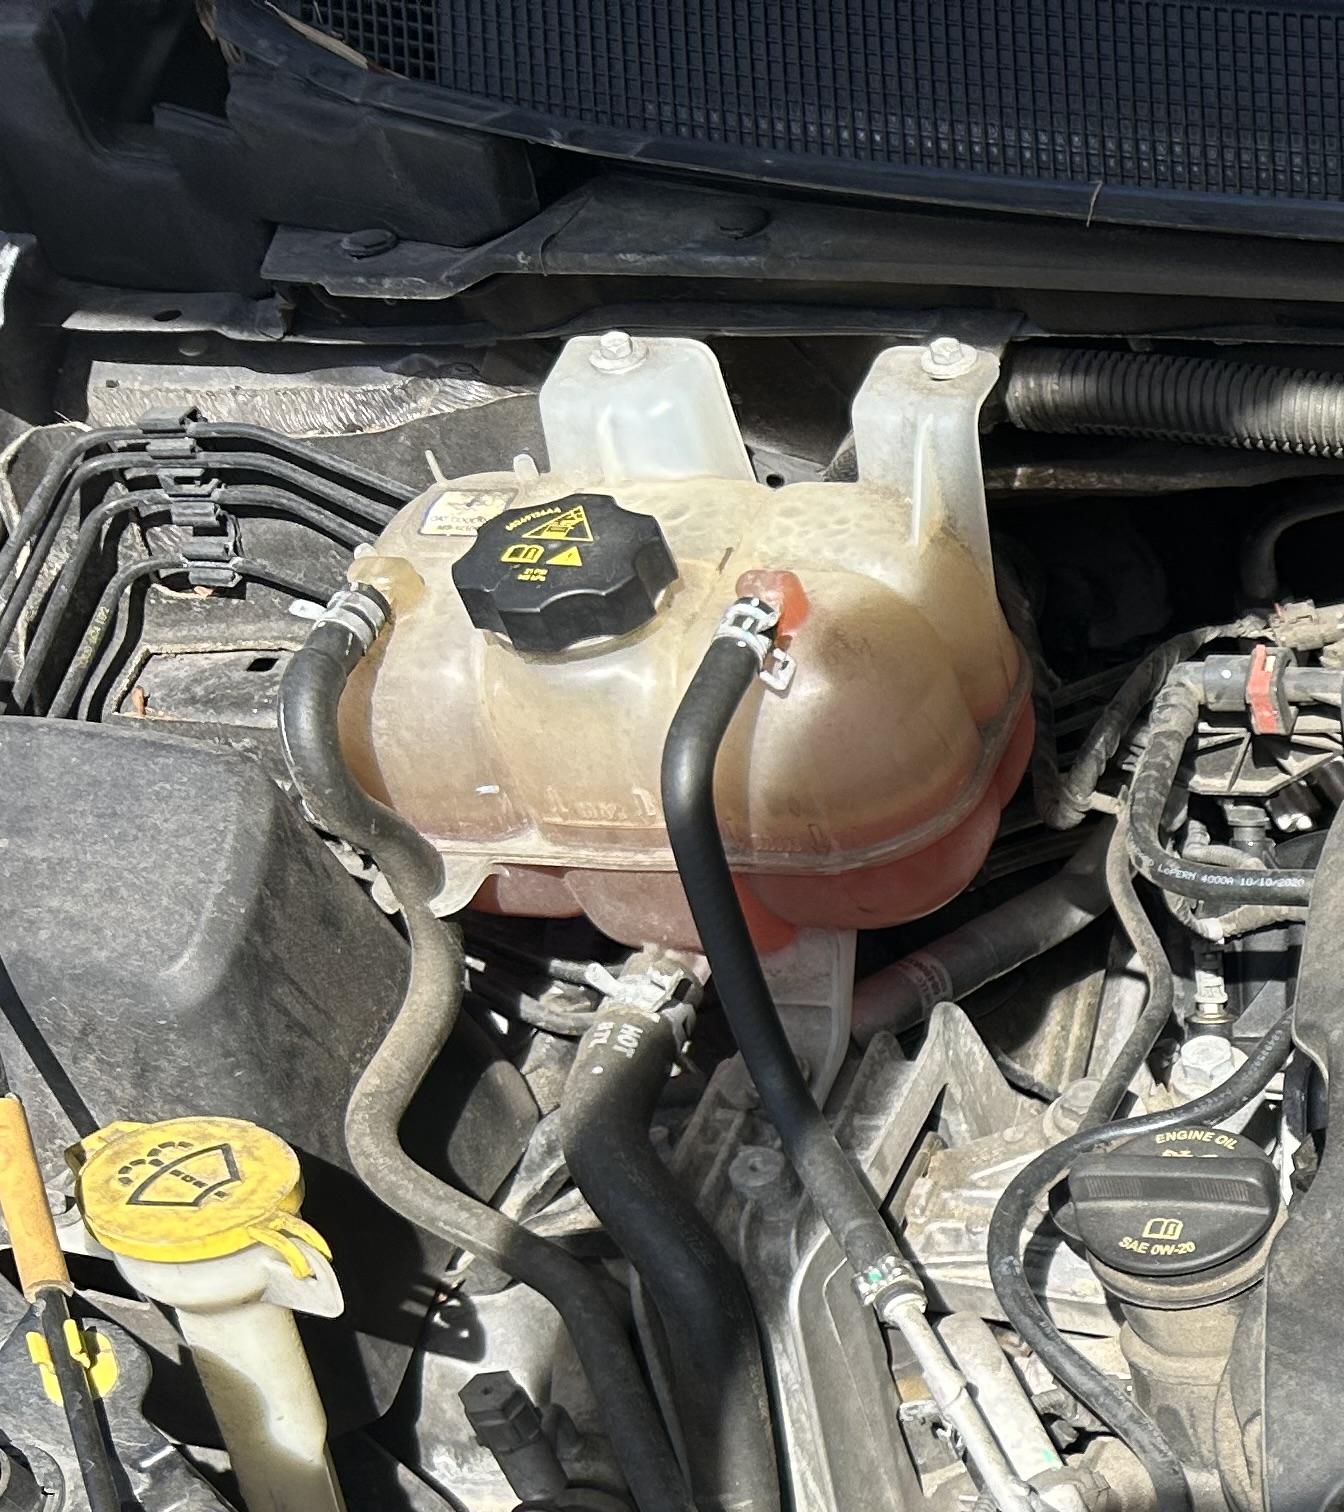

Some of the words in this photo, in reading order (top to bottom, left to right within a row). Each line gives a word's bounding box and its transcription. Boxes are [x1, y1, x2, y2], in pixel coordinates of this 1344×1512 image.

[613, 1023, 644, 1059] HOT
[1155, 1130, 1214, 1145] ENGINE
[1214, 1134, 1240, 1151] OIL
[1118, 1236, 1151, 1255] SAE
[1150, 1241, 1197, 1256] 0W-20
